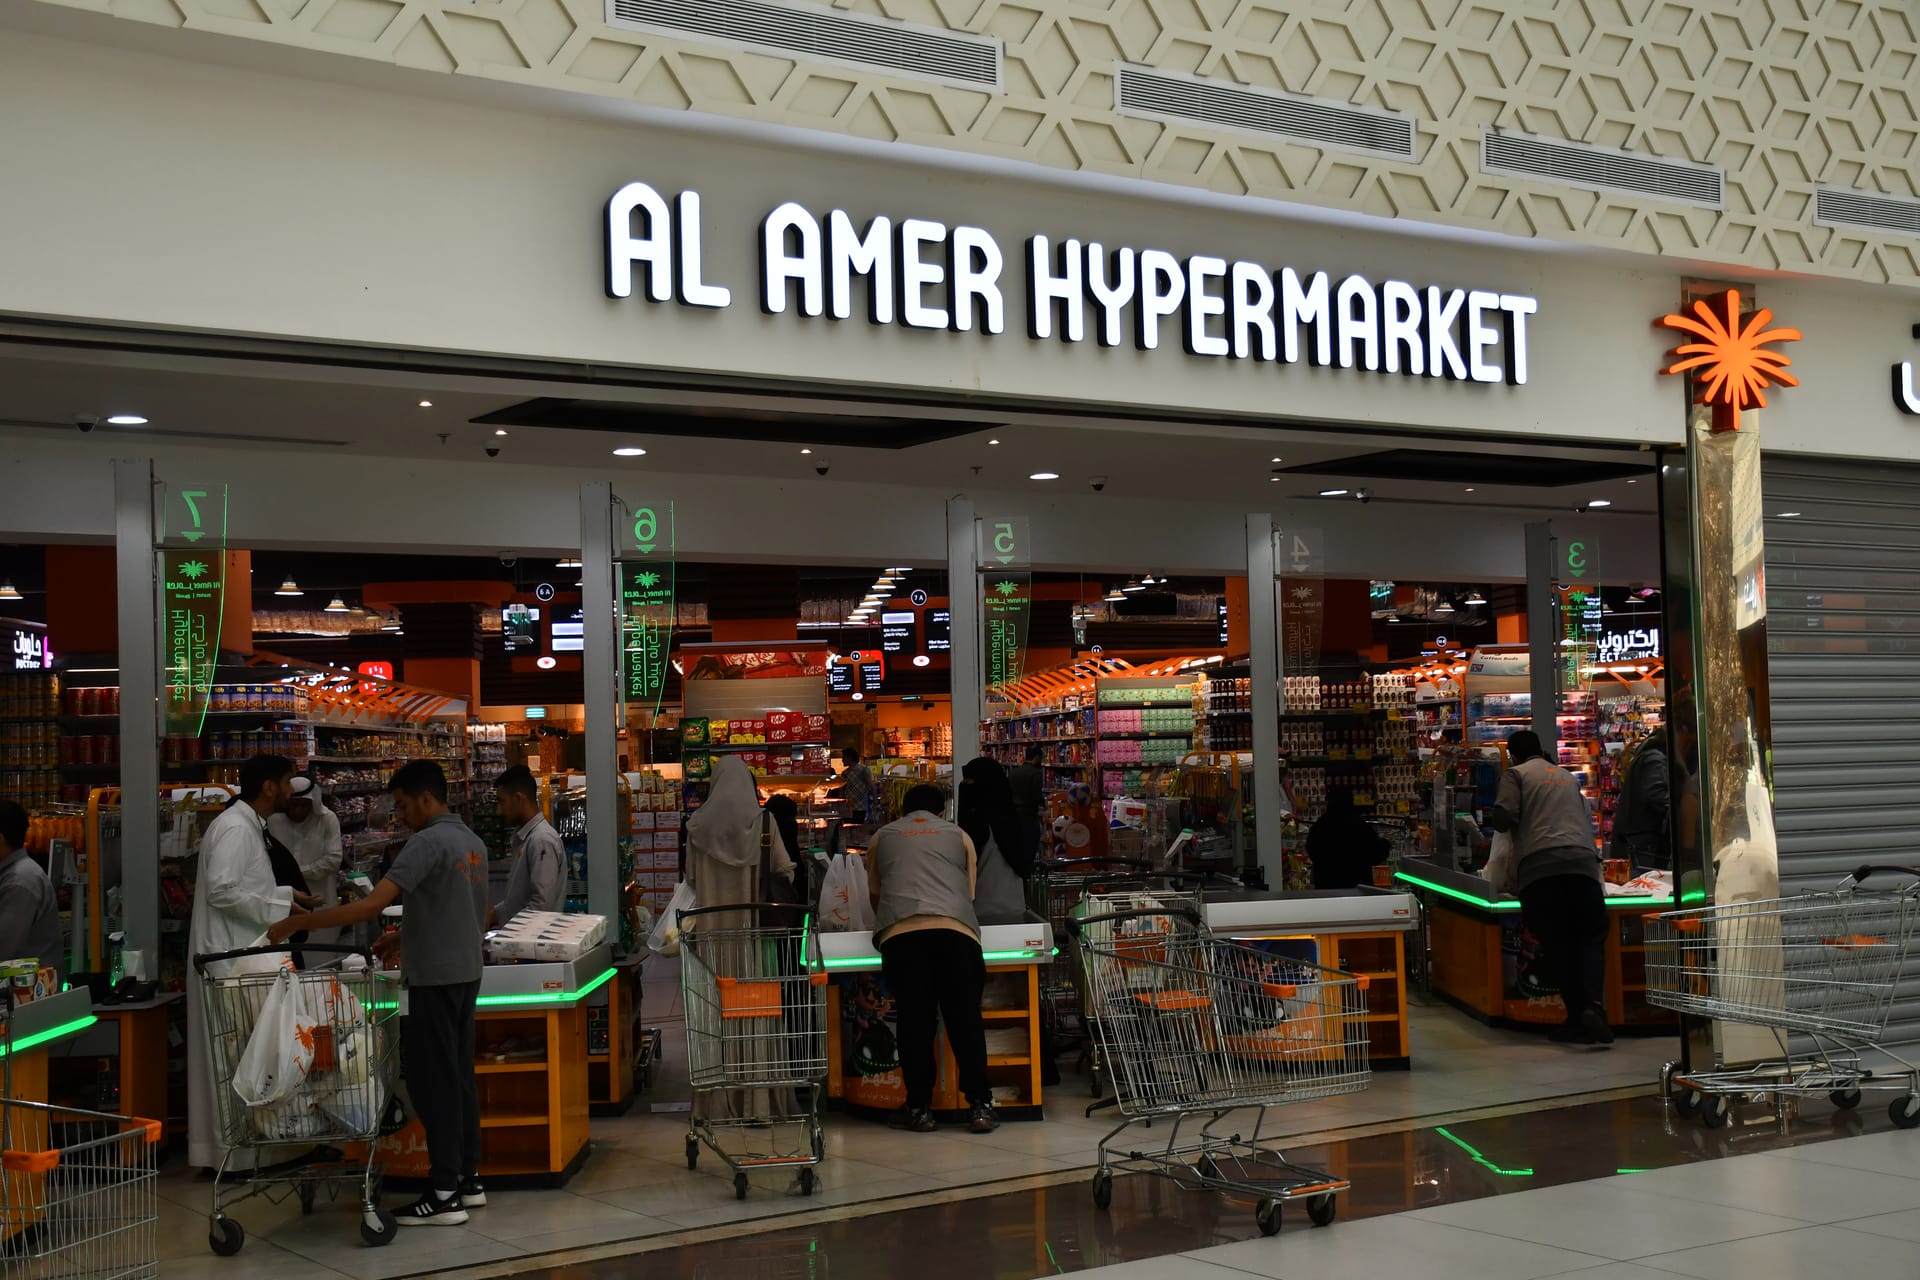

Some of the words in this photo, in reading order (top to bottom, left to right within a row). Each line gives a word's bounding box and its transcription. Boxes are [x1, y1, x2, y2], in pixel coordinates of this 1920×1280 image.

[604, 181, 731, 309] AL
[758, 202, 1004, 336] AMER
[1027, 233, 1537, 386] HYPERMARKET
[14, 630, 42, 660] حلويات
[1596, 629, 1659, 653] إلكتروني
